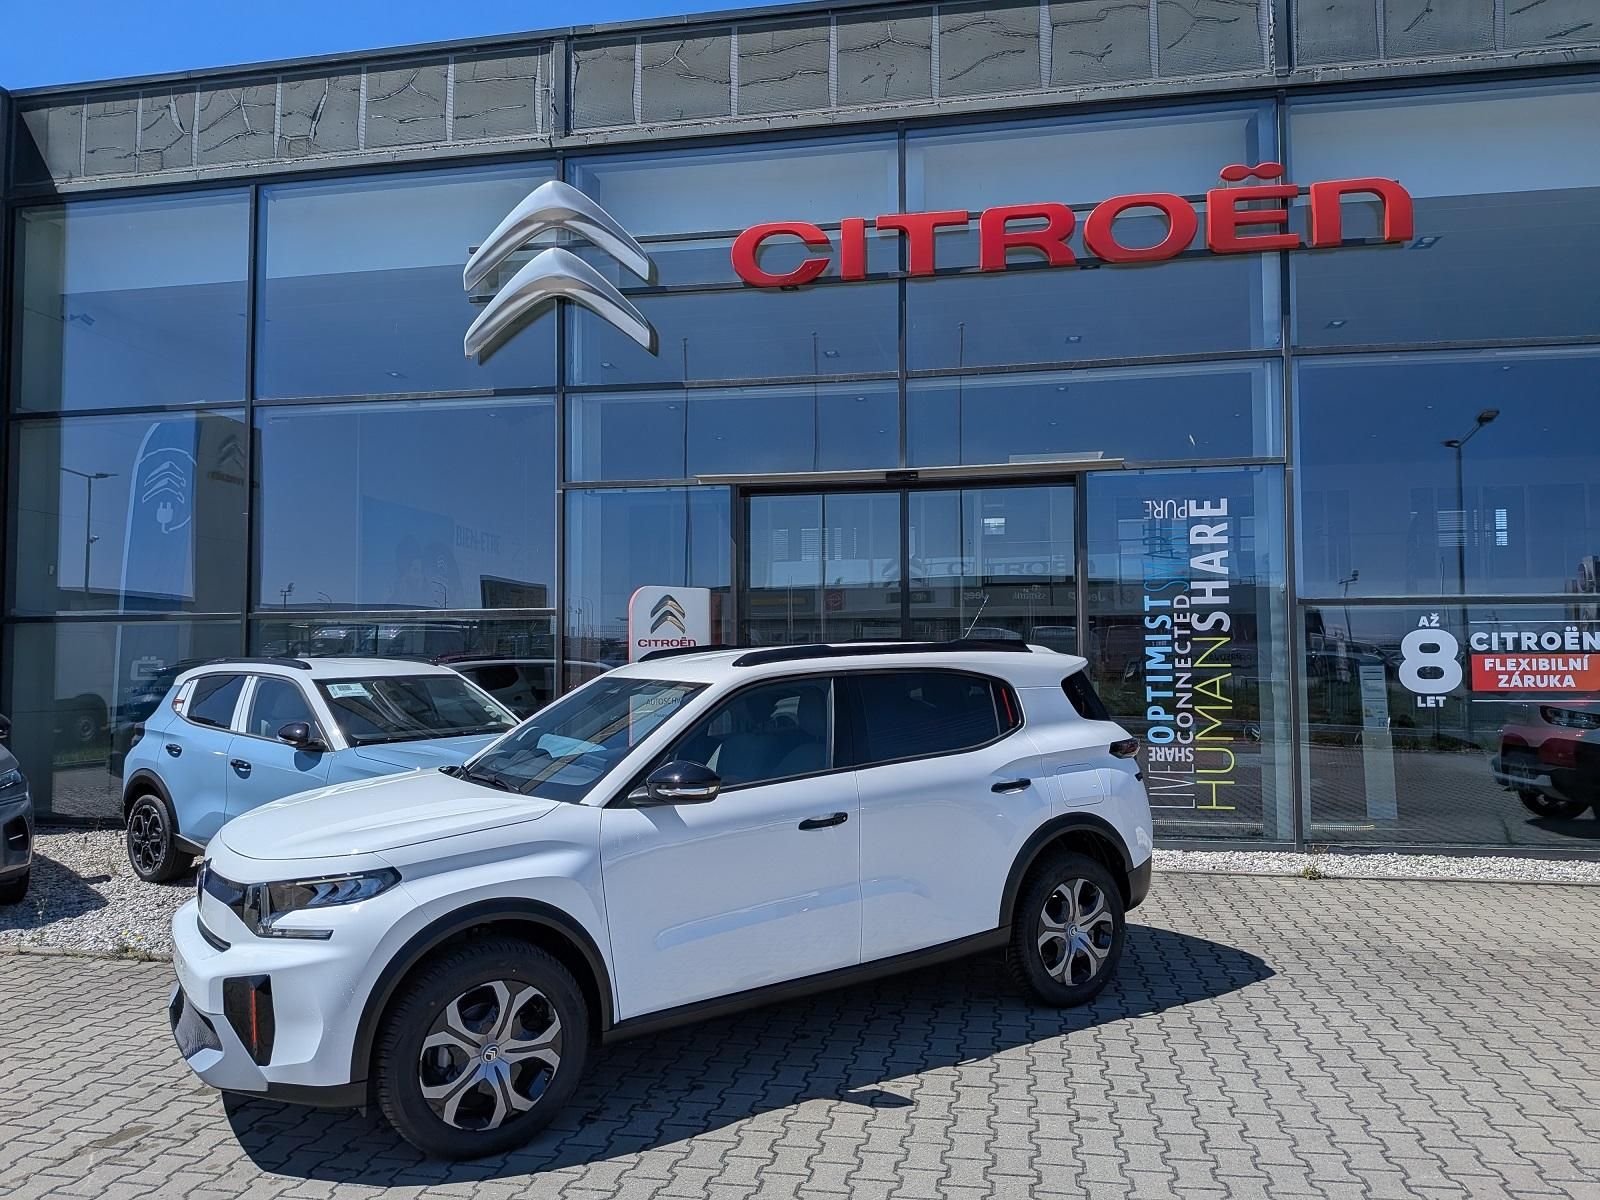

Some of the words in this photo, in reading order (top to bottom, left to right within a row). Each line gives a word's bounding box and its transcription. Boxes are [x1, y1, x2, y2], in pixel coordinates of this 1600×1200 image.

[1143, 499, 1188, 519] PURE
[1142, 524, 1190, 593] SMART
[1189, 497, 1231, 633] SHARE
[1418, 612, 1440, 628] AŽ
[1470, 626, 1600, 651] CITROËN
[1144, 596, 1175, 744] OPTIMIST
[1173, 594, 1194, 745] CONNECTED
[1399, 628, 1463, 694] 8
[1484, 654, 1589, 671] FLEXIBILNÍ
[1498, 671, 1576, 688] ZÁRUKA
[1417, 695, 1447, 708] LET
[1192, 636, 1236, 811] HUMAN
[1147, 745, 1194, 762] SHARE
[1148, 763, 1195, 809] LIVE
